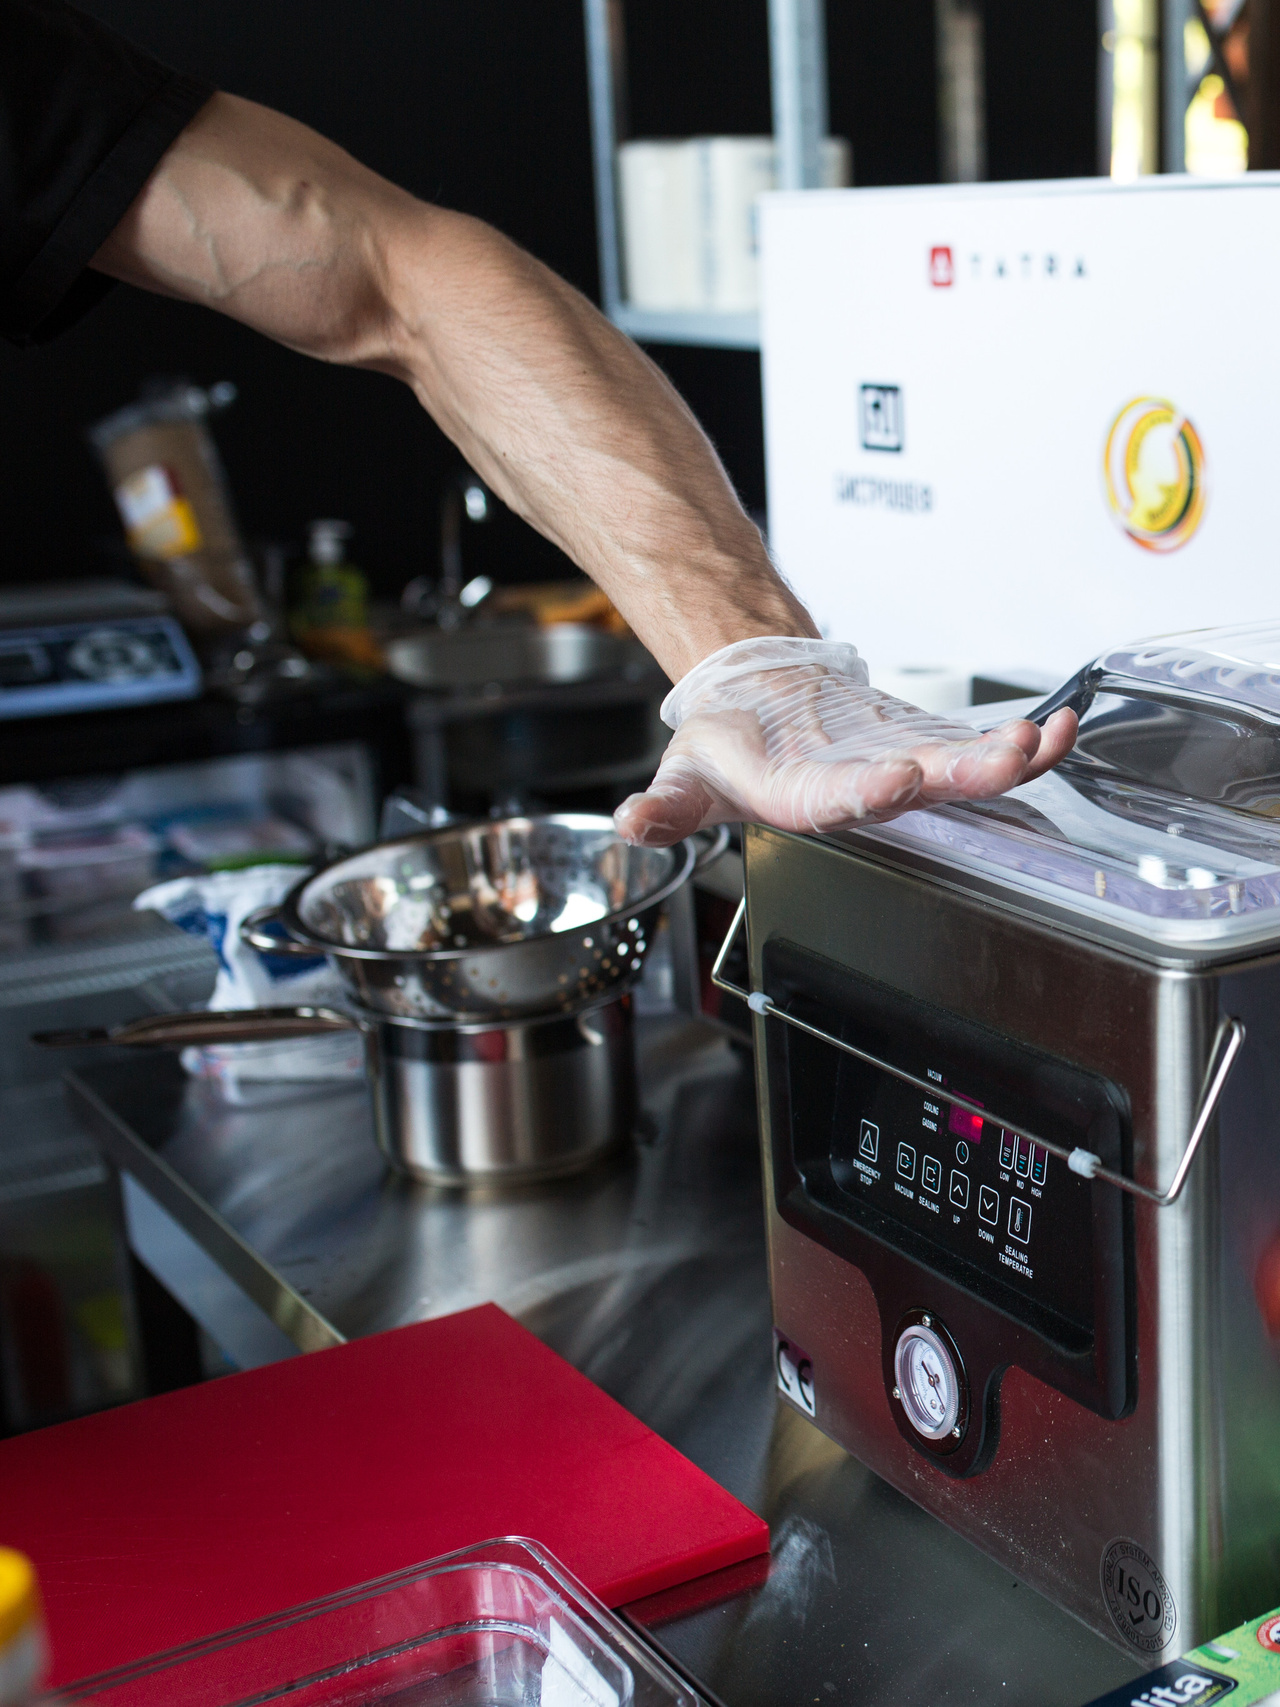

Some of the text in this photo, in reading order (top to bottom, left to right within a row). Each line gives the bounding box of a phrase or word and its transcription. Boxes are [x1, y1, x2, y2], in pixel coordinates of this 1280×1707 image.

[968, 252, 1089, 281] TATRA
[927, 1068, 943, 1084] VACUUM
[923, 1100, 939, 1117] COOLING
[922, 1117, 938, 1133] GASSING
[853, 1158, 881, 1181] EMERGENCY
[1000, 1170, 1010, 1183] LOW
[860, 1173, 873, 1187] STOP
[1016, 1178, 1025, 1191] MID
[894, 1181, 914, 1200] VACUUM
[1031, 1185, 1042, 1199] HIGH
[918, 1195, 940, 1214] SEALING
[953, 1214, 961, 1225] UP
[978, 1228, 995, 1245] DOWN
[1004, 1244, 1028, 1265] SEALING
[998, 1252, 1034, 1279] TEMPERATRE
[1118, 1567, 1160, 1620] ISO
[1151, 1570, 1174, 1633] APPROVED
